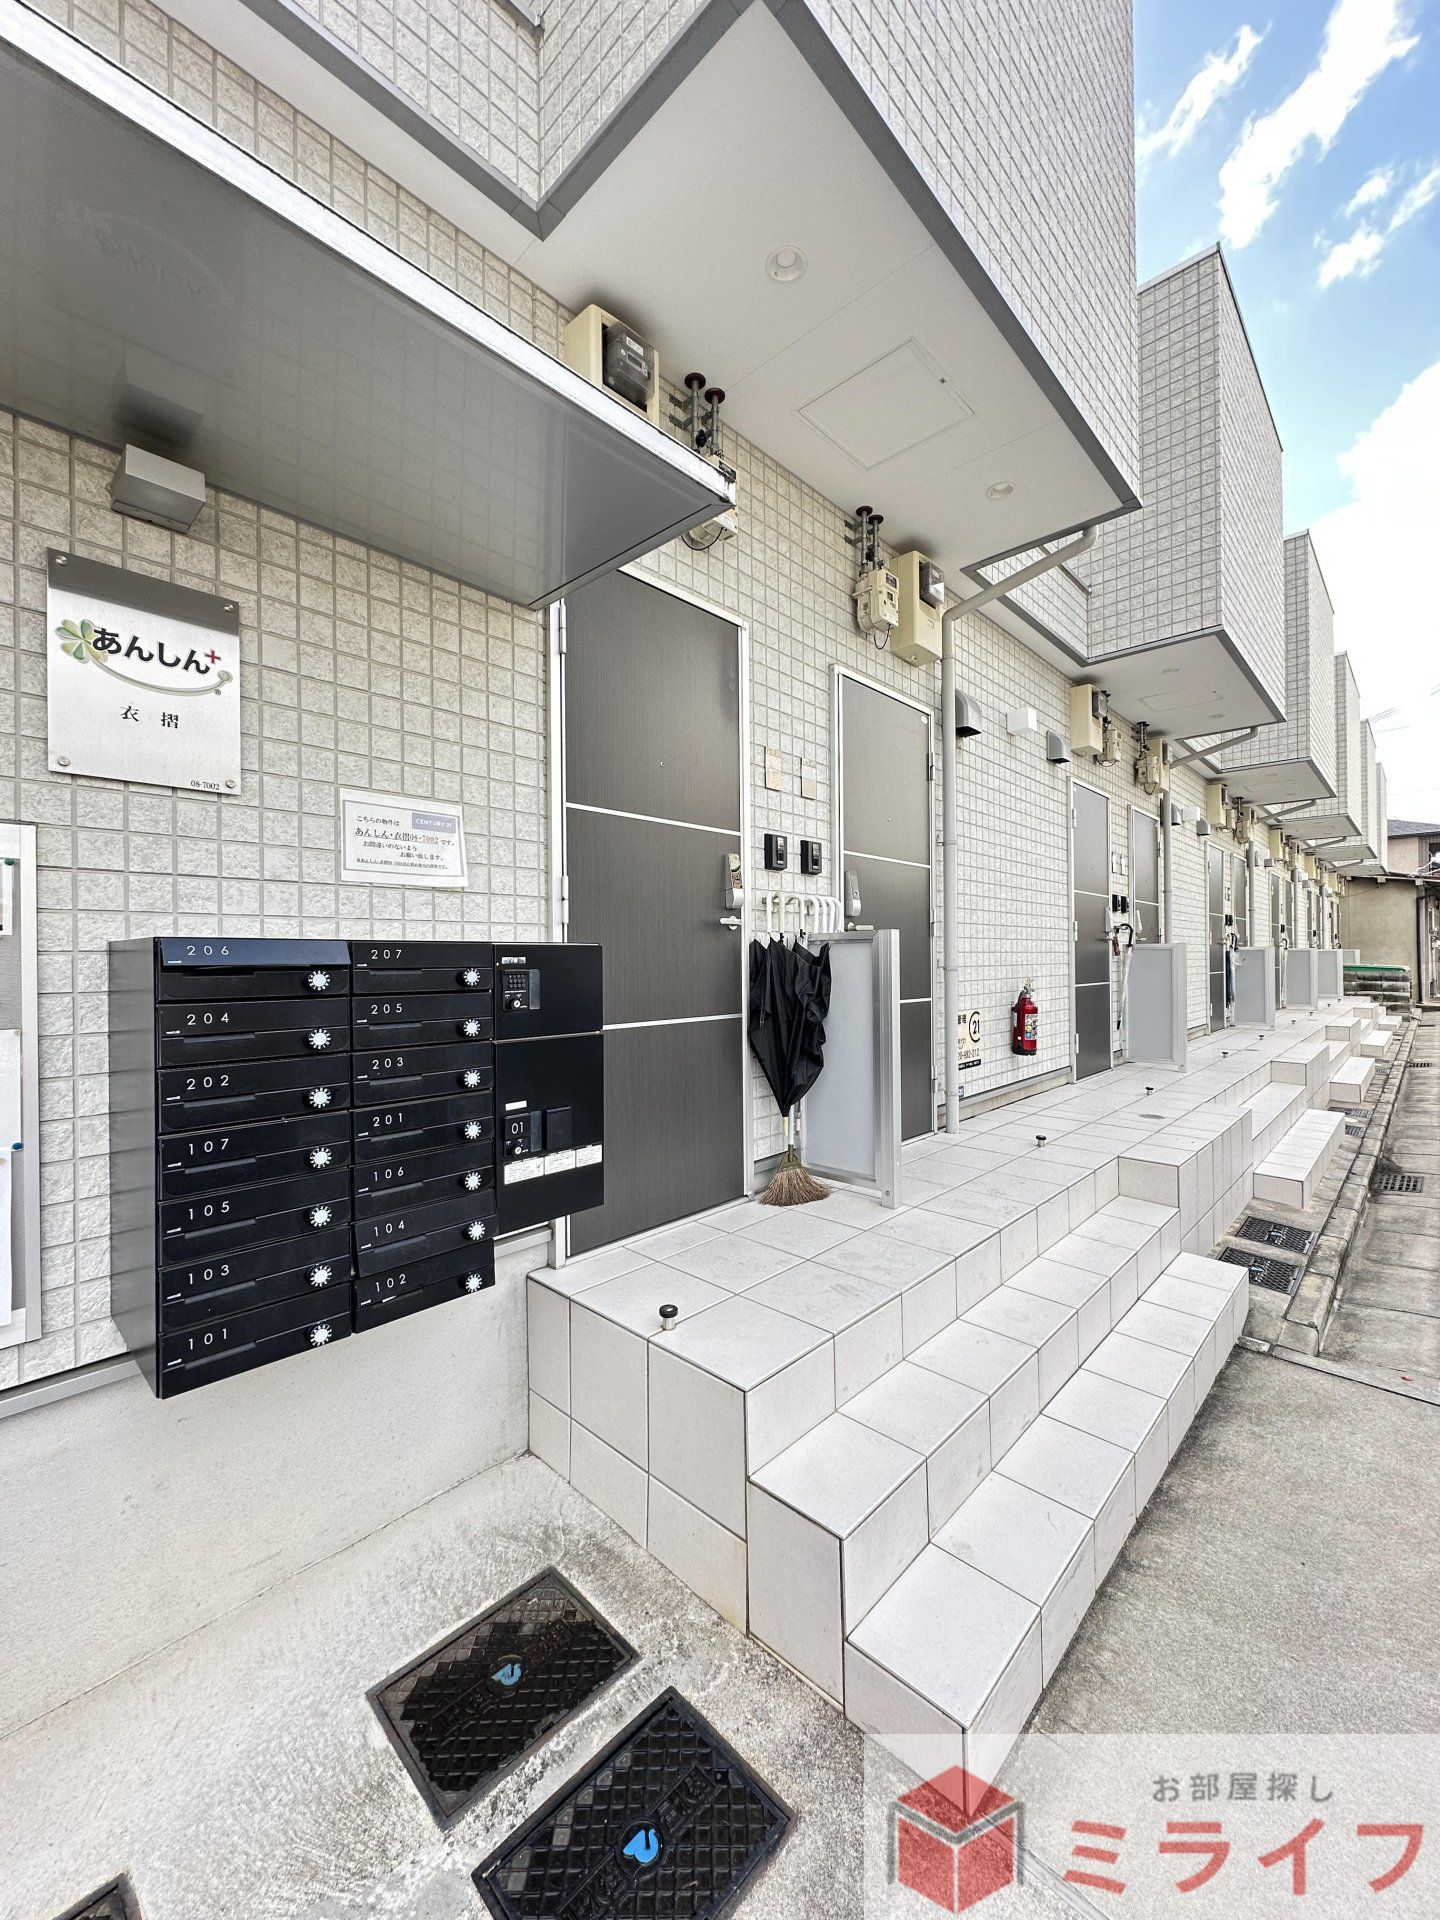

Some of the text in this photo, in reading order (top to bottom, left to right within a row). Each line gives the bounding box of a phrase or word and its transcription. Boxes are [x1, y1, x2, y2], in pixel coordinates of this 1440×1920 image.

[190, 779, 220, 791] 08-7002
[415, 818, 445, 827] CENTURY
[186, 945, 229, 956] 206
[371, 949, 402, 960] 207
[371, 1003, 403, 1015] 205
[186, 1012, 230, 1026] 204
[372, 1056, 404, 1070] 203
[186, 1074, 229, 1091] 202
[372, 1112, 403, 1127] 201
[511, 1120, 524, 1136] 01
[188, 1138, 229, 1155] 107
[373, 1166, 404, 1182] 106
[188, 1200, 230, 1220] 105
[374, 1219, 405, 1237] 104
[188, 1264, 230, 1285] 103
[375, 1273, 407, 1293] 102
[188, 1328, 228, 1351] 101
